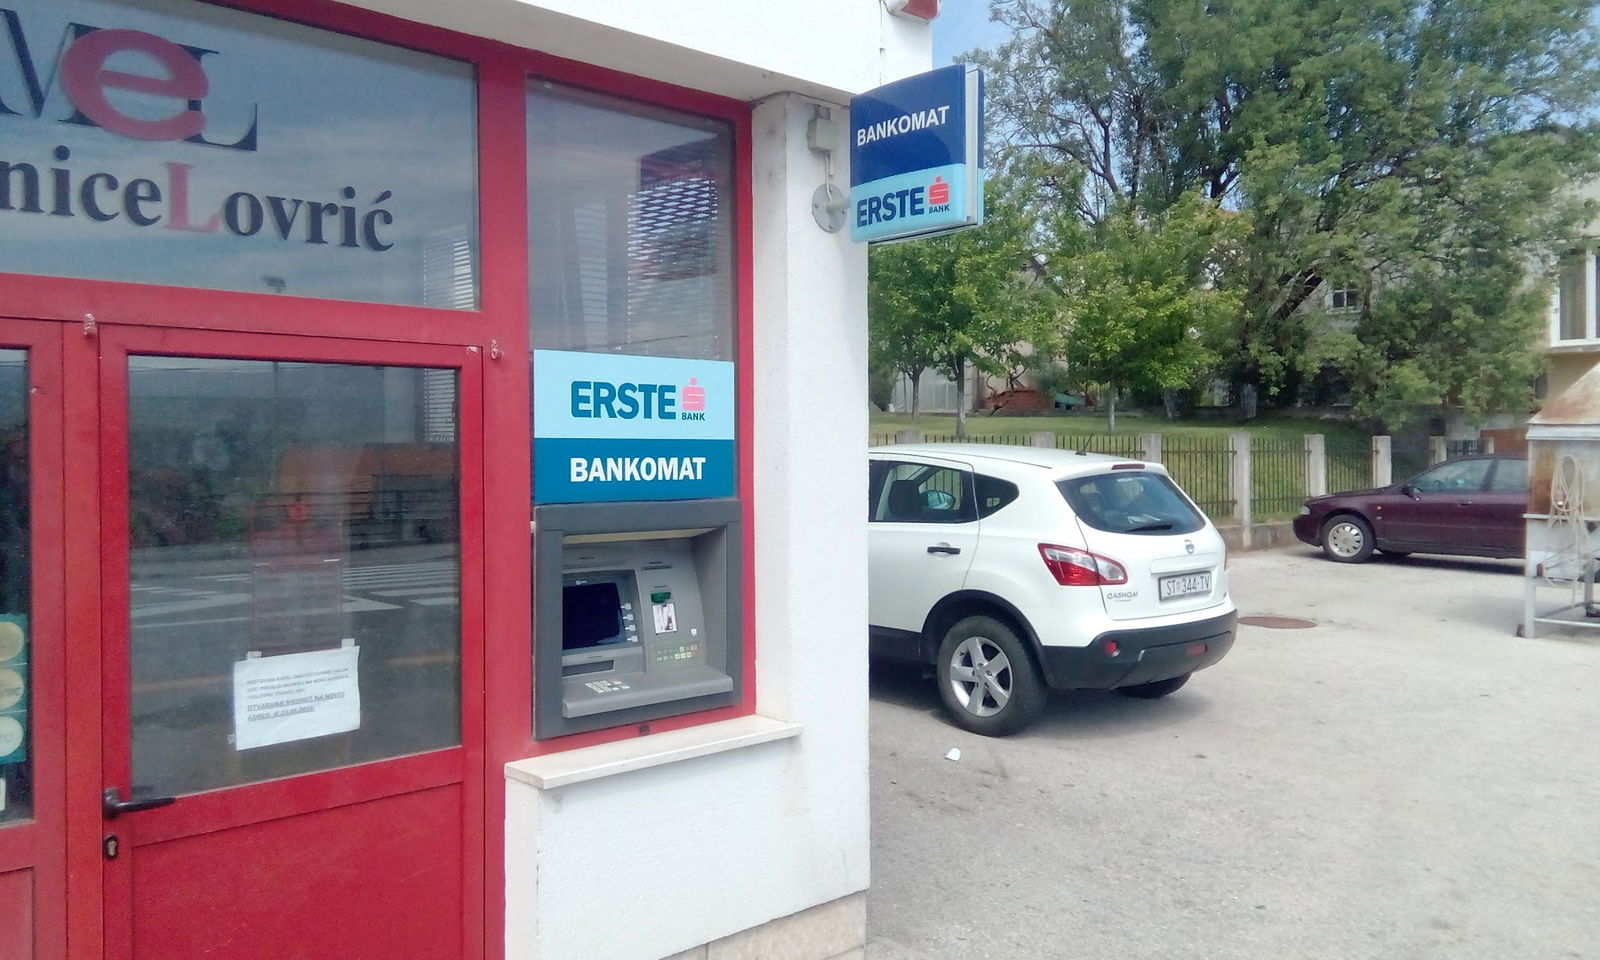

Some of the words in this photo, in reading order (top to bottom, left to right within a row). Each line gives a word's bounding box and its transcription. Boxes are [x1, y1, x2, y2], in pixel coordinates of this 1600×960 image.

[857, 105, 950, 146] BANKOMAT
[857, 186, 925, 228] ERSTE
[928, 204, 950, 214] BANK
[571, 380, 677, 420] ERSTE
[681, 412, 706, 421] BANK
[570, 457, 706, 483] BANKOMAT
[1166, 580, 1176, 595] ST
